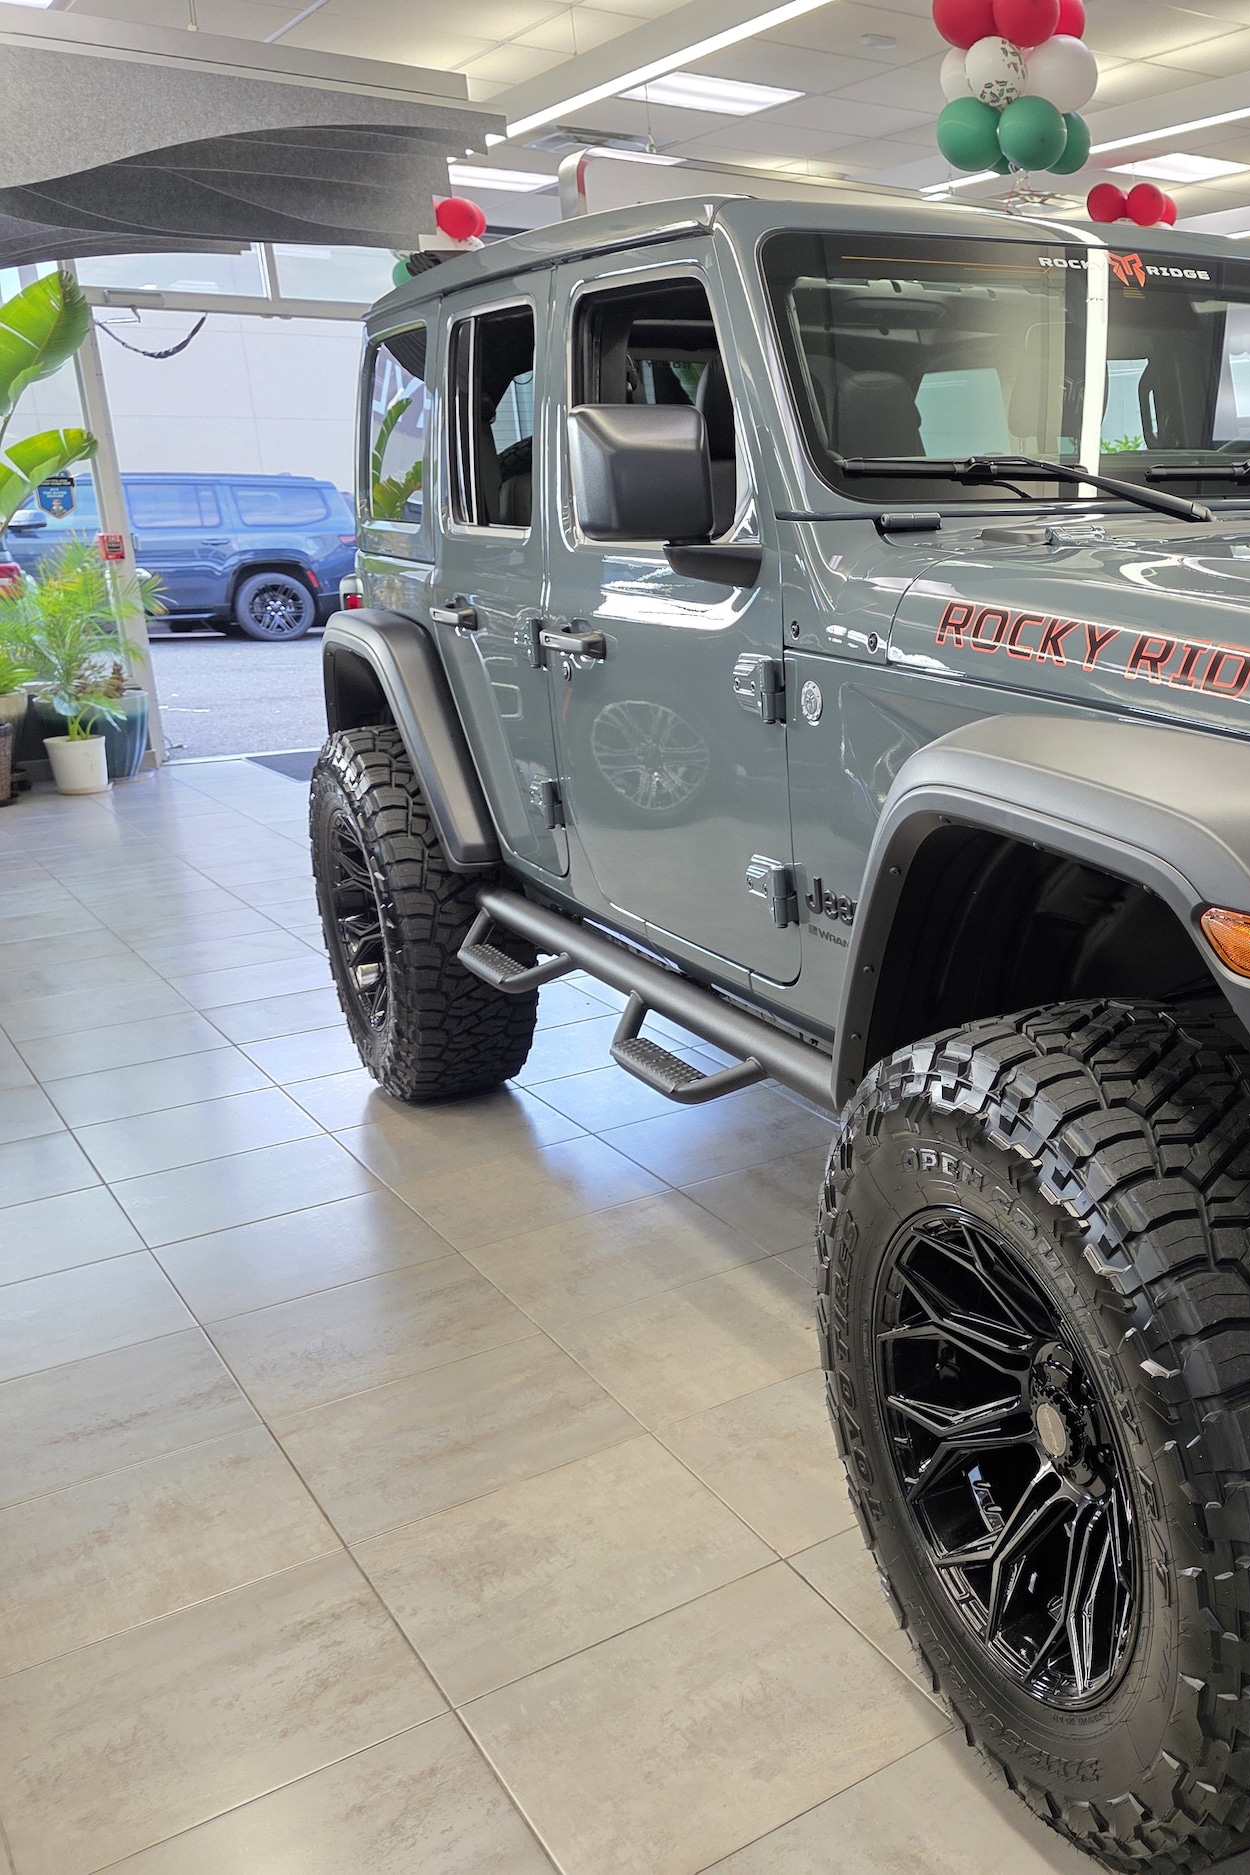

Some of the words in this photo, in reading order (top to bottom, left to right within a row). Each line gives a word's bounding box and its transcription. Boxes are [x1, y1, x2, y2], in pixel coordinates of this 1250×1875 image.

[1145, 265, 1210, 280] RIDGE
[937, 600, 1122, 672] ROCKY
[900, 1147, 984, 1190] OPEN
